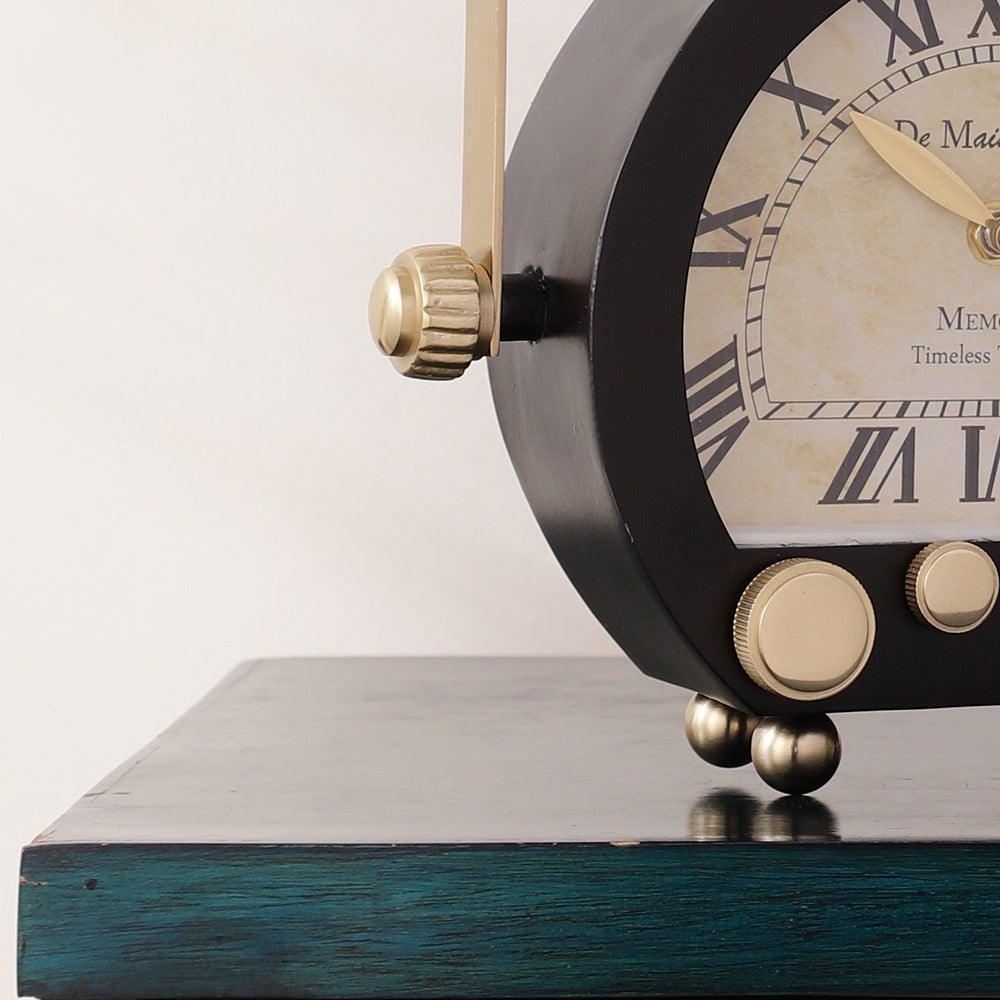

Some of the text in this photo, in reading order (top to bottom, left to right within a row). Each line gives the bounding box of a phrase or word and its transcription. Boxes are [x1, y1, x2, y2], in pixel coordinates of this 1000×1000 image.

[760, 58, 841, 140] X
[689, 193, 770, 270] IX
[911, 344, 991, 364] Timeless
